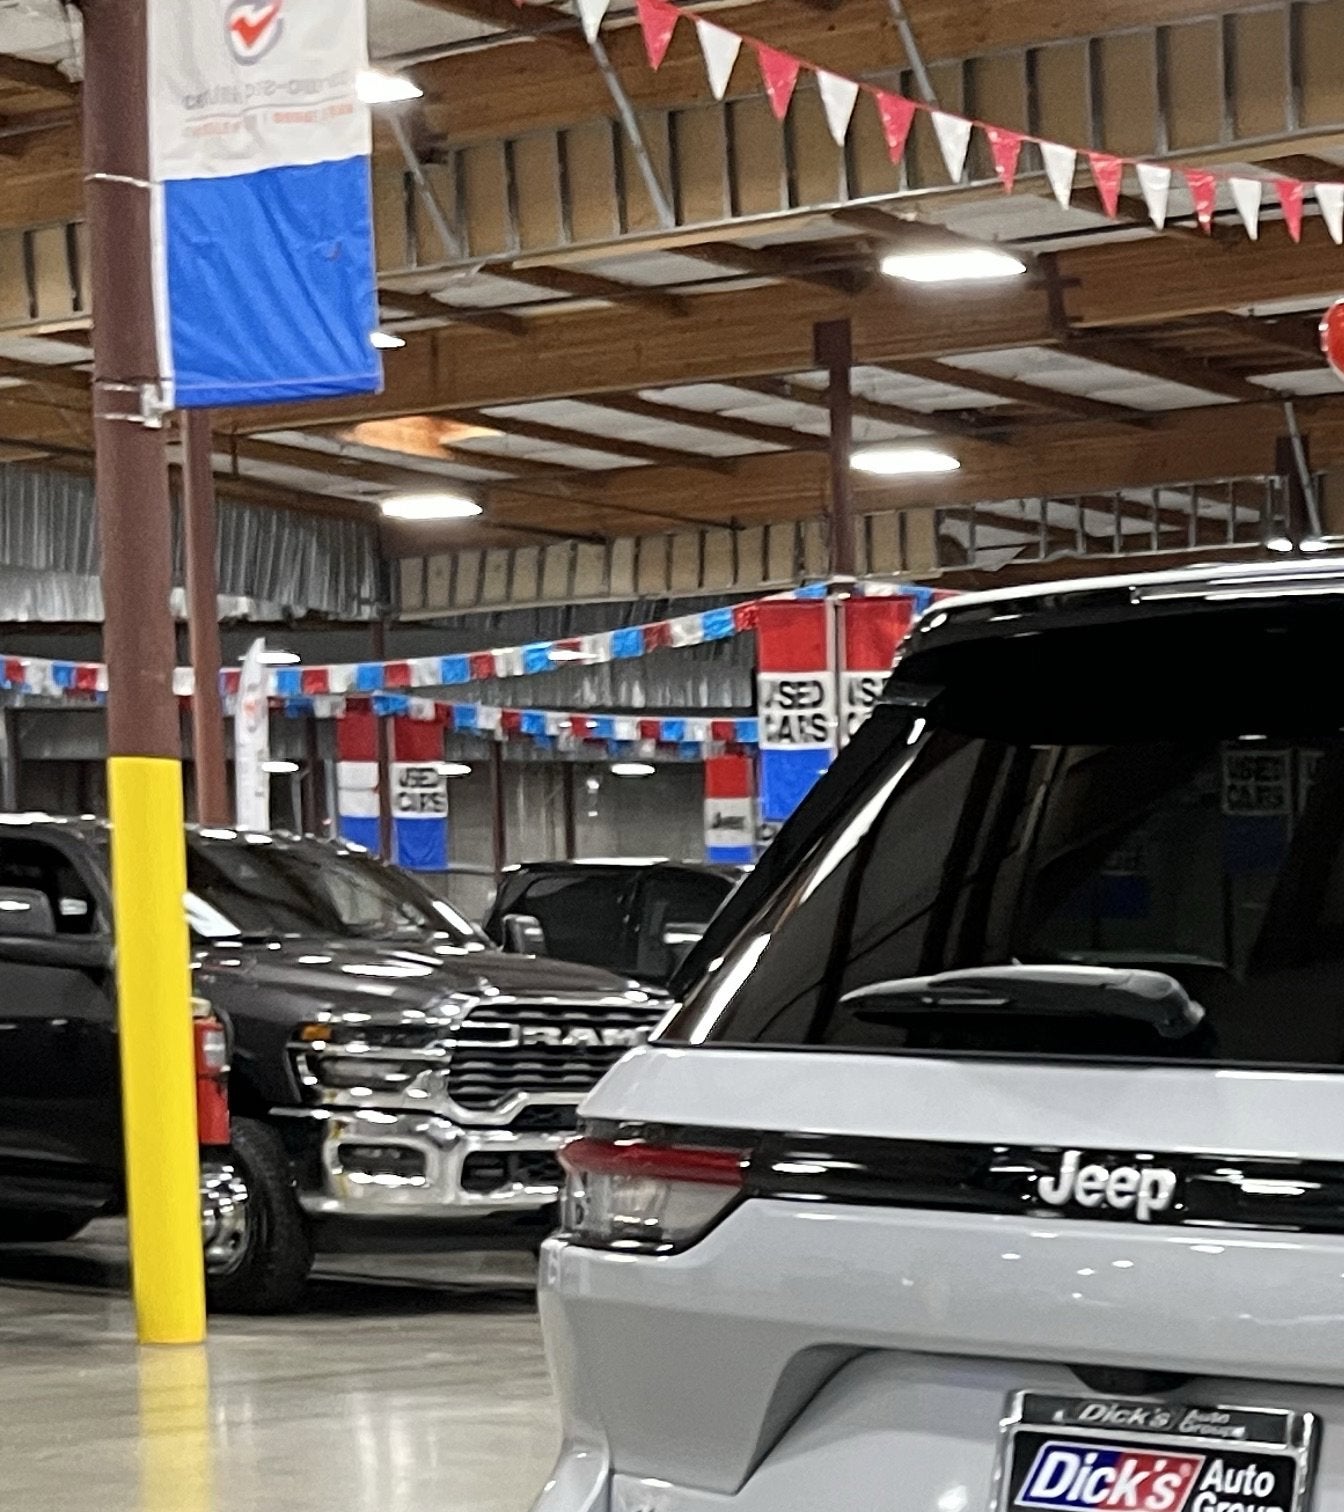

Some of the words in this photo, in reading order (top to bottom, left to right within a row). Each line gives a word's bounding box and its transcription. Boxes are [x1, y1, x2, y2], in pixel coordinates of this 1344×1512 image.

[1037, 1149, 1177, 1222] Jeep
[1078, 1402, 1171, 1428] Dick's
[1029, 1450, 1183, 1511] Dick's
[1199, 1458, 1275, 1498] Auto
